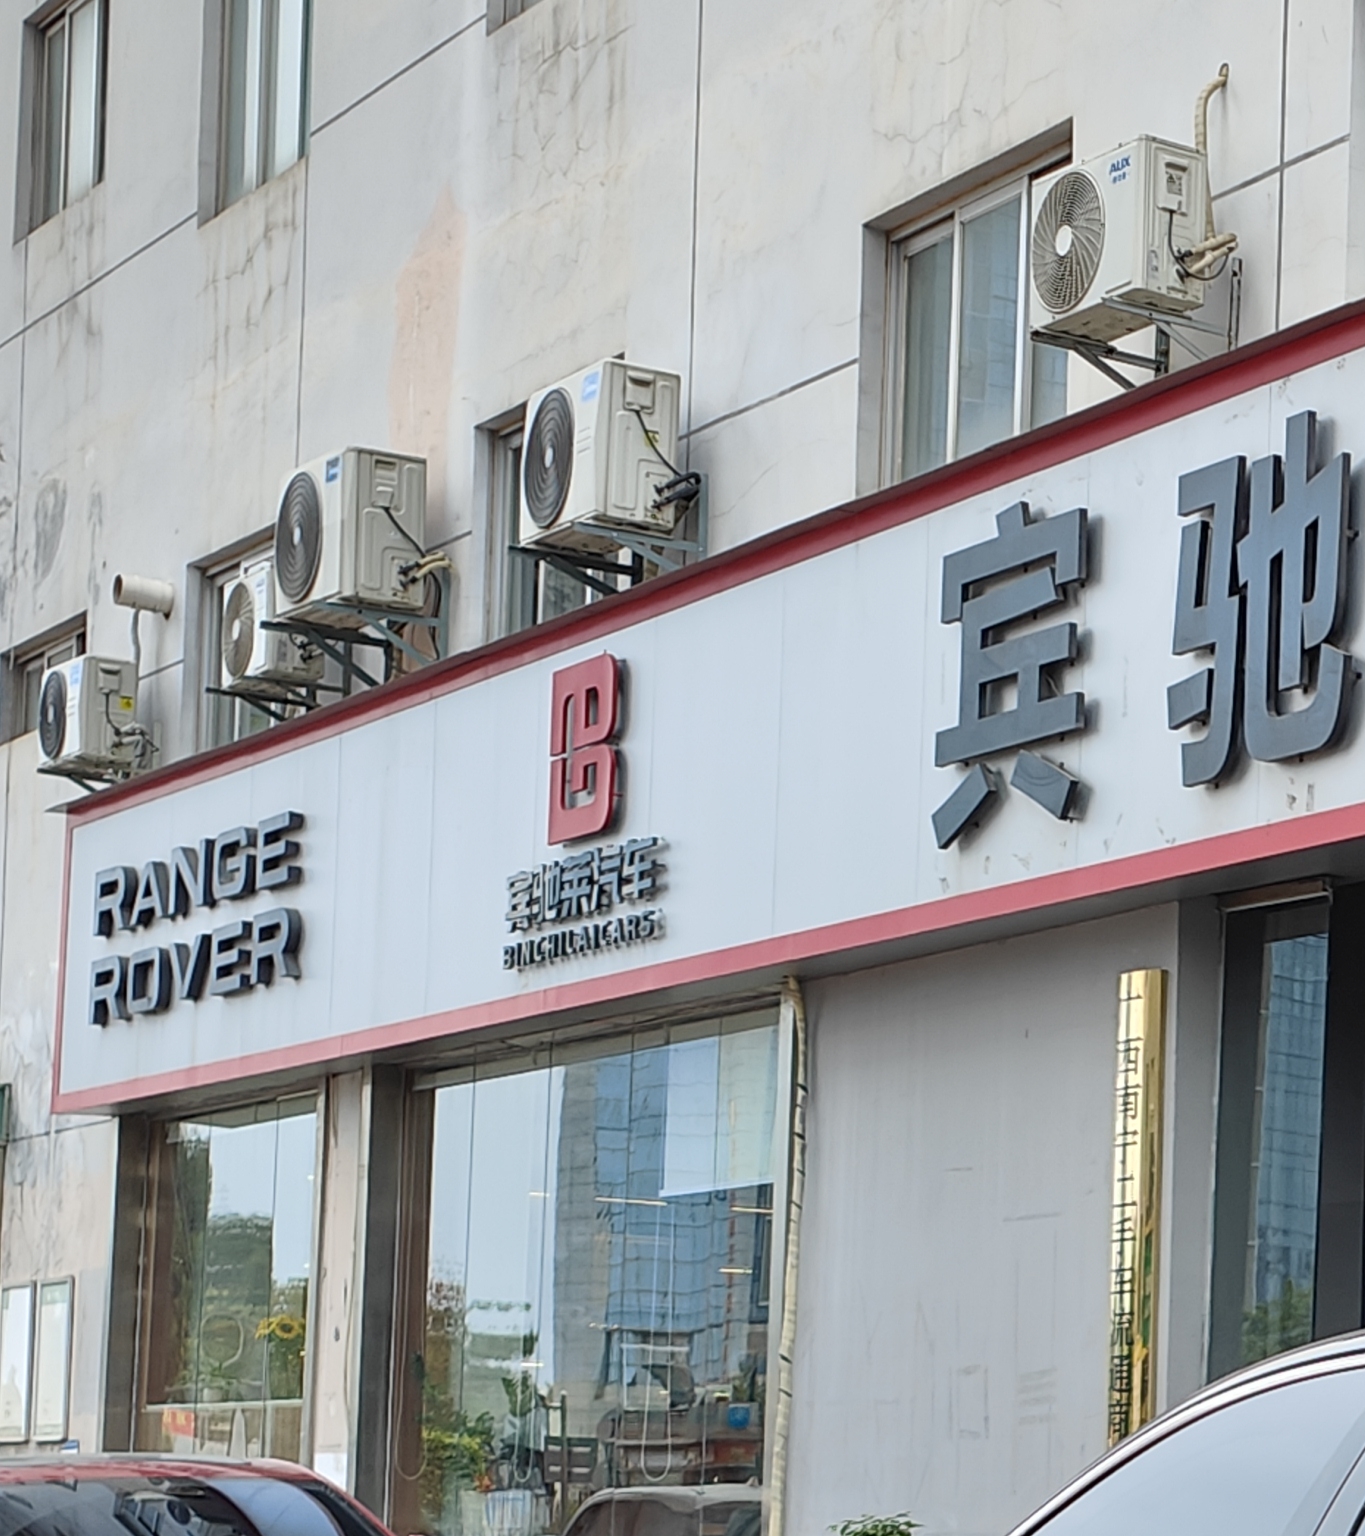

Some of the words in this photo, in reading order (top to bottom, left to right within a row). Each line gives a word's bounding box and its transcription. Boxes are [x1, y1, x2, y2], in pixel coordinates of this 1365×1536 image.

[1108, 155, 1131, 176] AUX
[92, 811, 305, 937] RANGE
[89, 908, 304, 1027] ROVER
